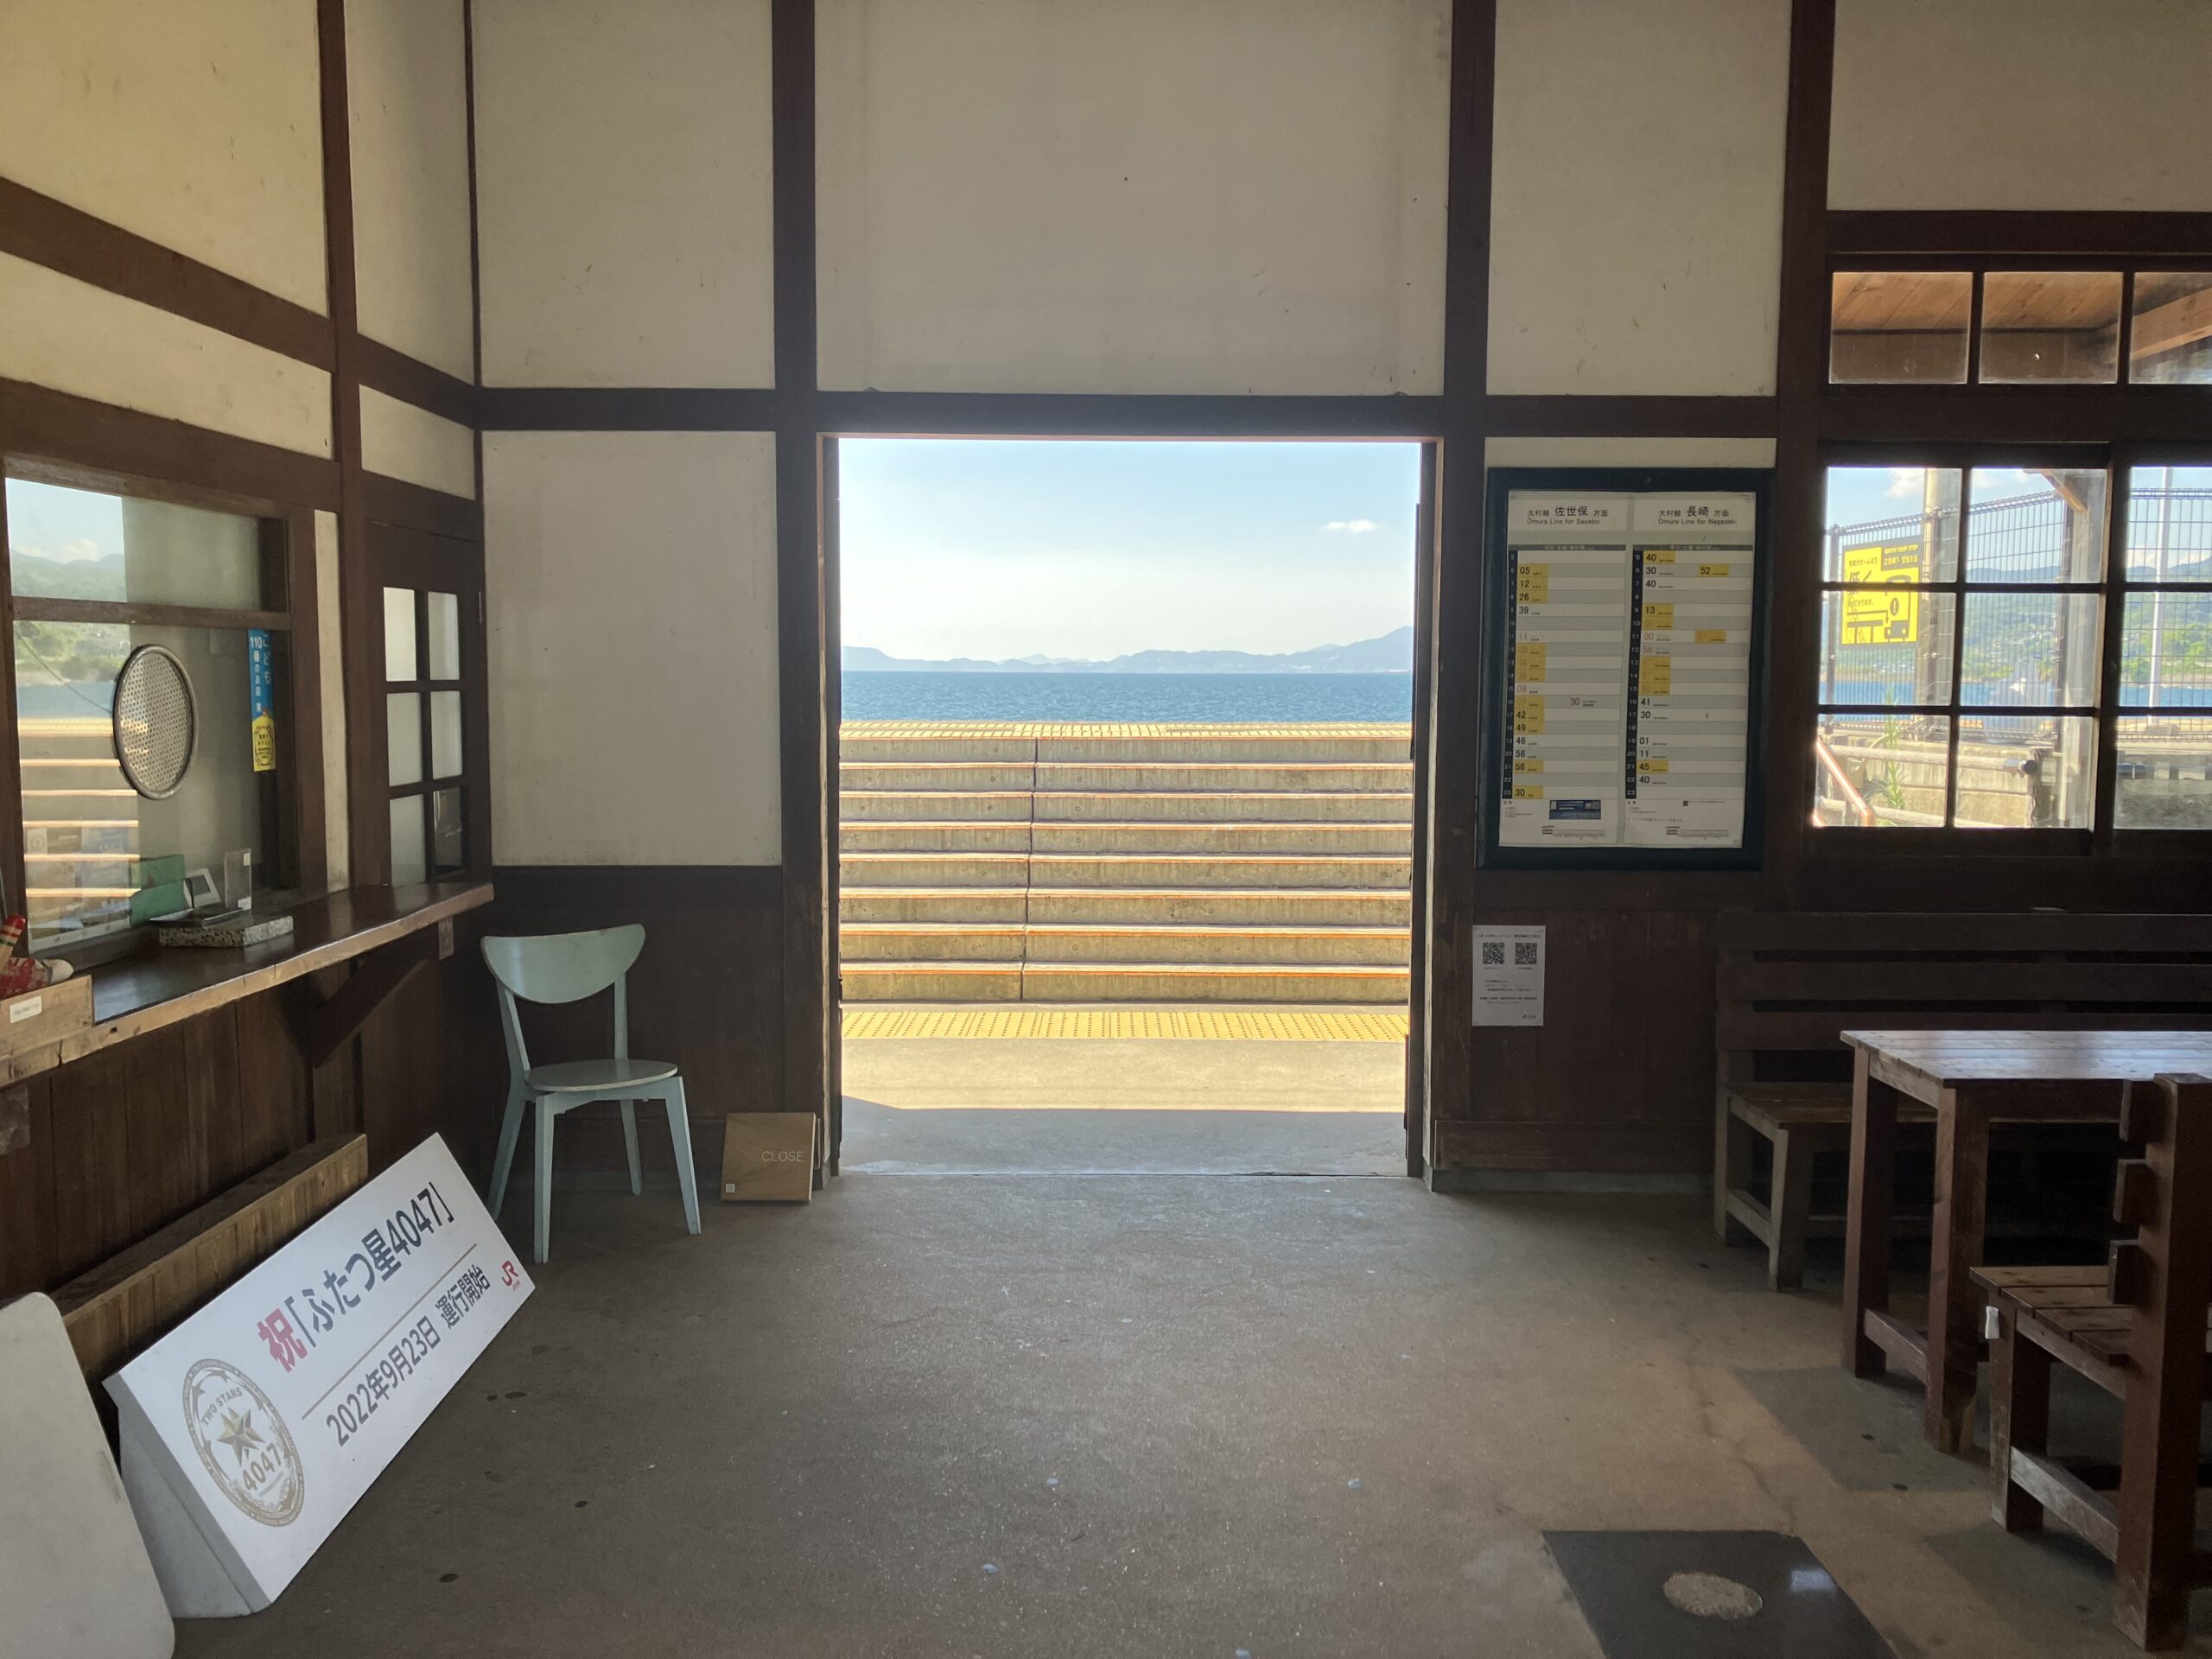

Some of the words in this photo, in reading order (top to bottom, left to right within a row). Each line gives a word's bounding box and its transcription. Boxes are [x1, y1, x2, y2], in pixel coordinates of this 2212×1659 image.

[1555, 505, 1588, 517] 佐世保
[1687, 505, 1709, 517] 長崎
[1519, 593, 1529, 601] 26
[761, 1150, 804, 1162] CLOSE
[502, 1260, 518, 1287] JR
[326, 1316, 442, 1446] 2022年9月23日
[435, 1264, 491, 1329] 運行開始
[201, 1402, 218, 1427] TWO
[216, 1387, 243, 1408] STARS
[242, 1443, 282, 1491] 4047
